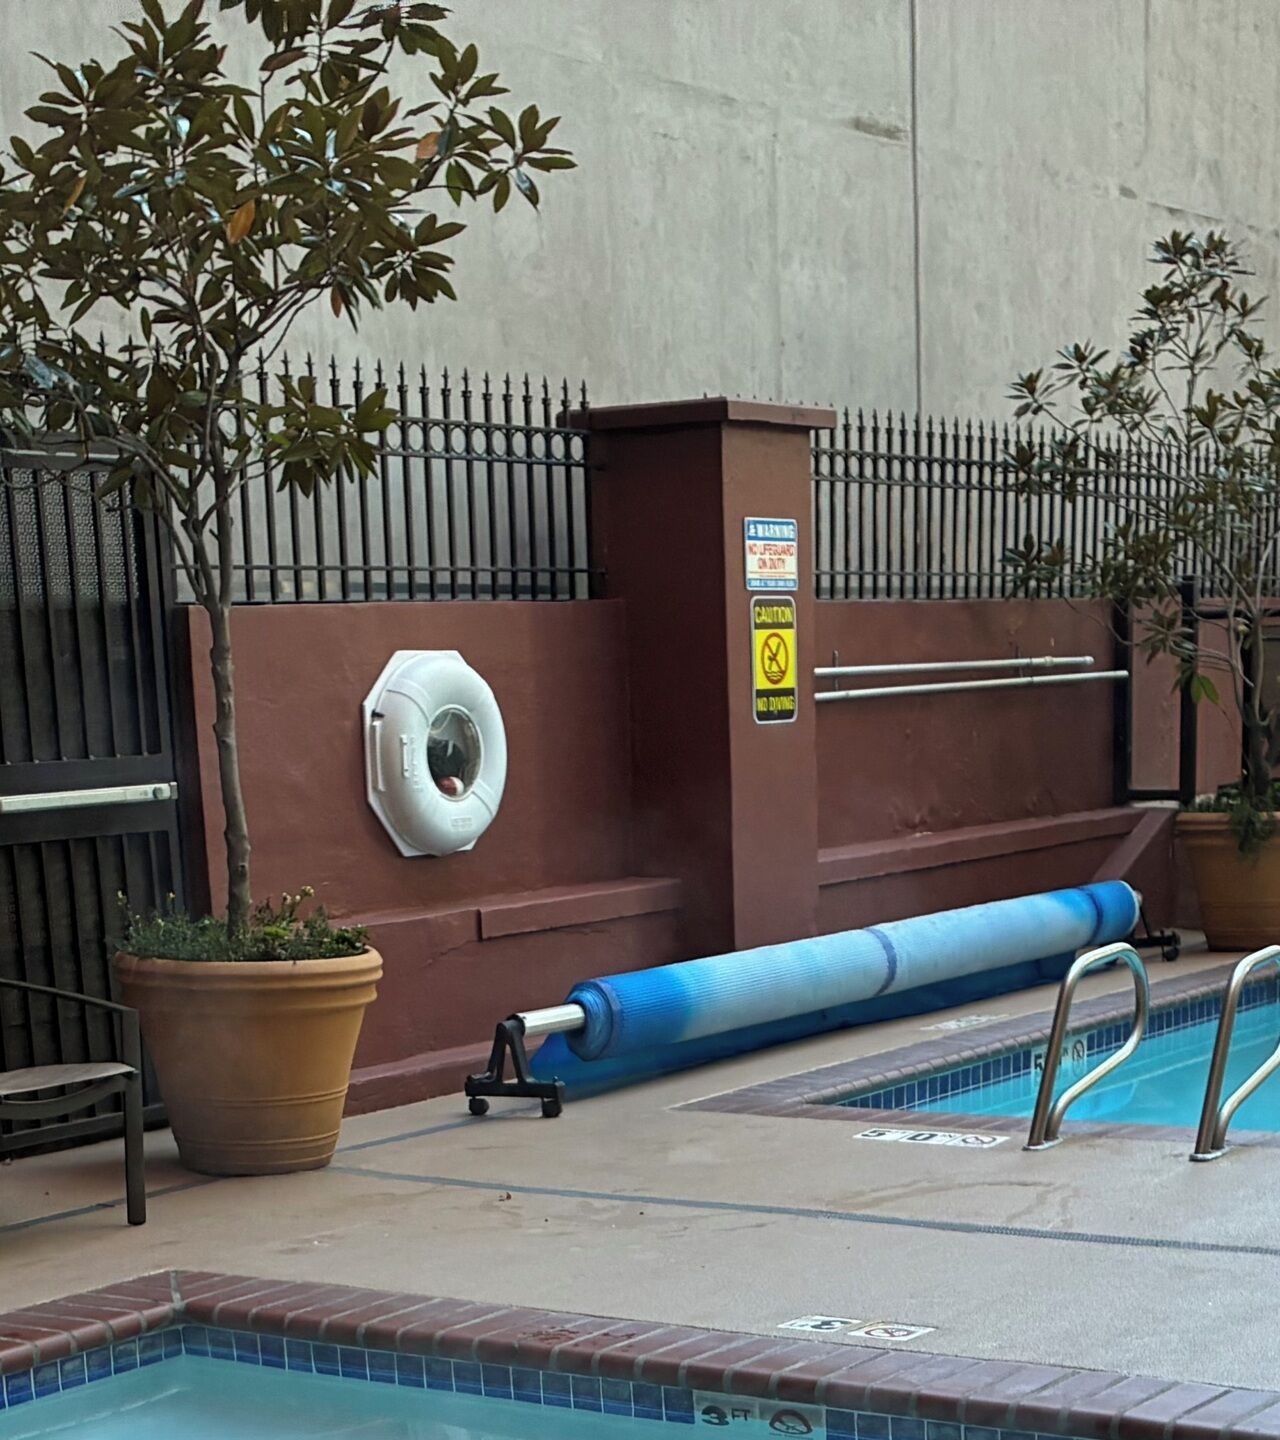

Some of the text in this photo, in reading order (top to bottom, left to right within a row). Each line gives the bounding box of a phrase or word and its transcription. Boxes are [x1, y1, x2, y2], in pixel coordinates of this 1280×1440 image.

[748, 543, 795, 557] NO LIFEGUARD
[757, 557, 786, 570] ON DUTY
[754, 606, 793, 624] CAUTION
[757, 695, 795, 712] NO DIVING
[861, 1129, 889, 1138] 5
[701, 1405, 751, 1426] 3 FT
